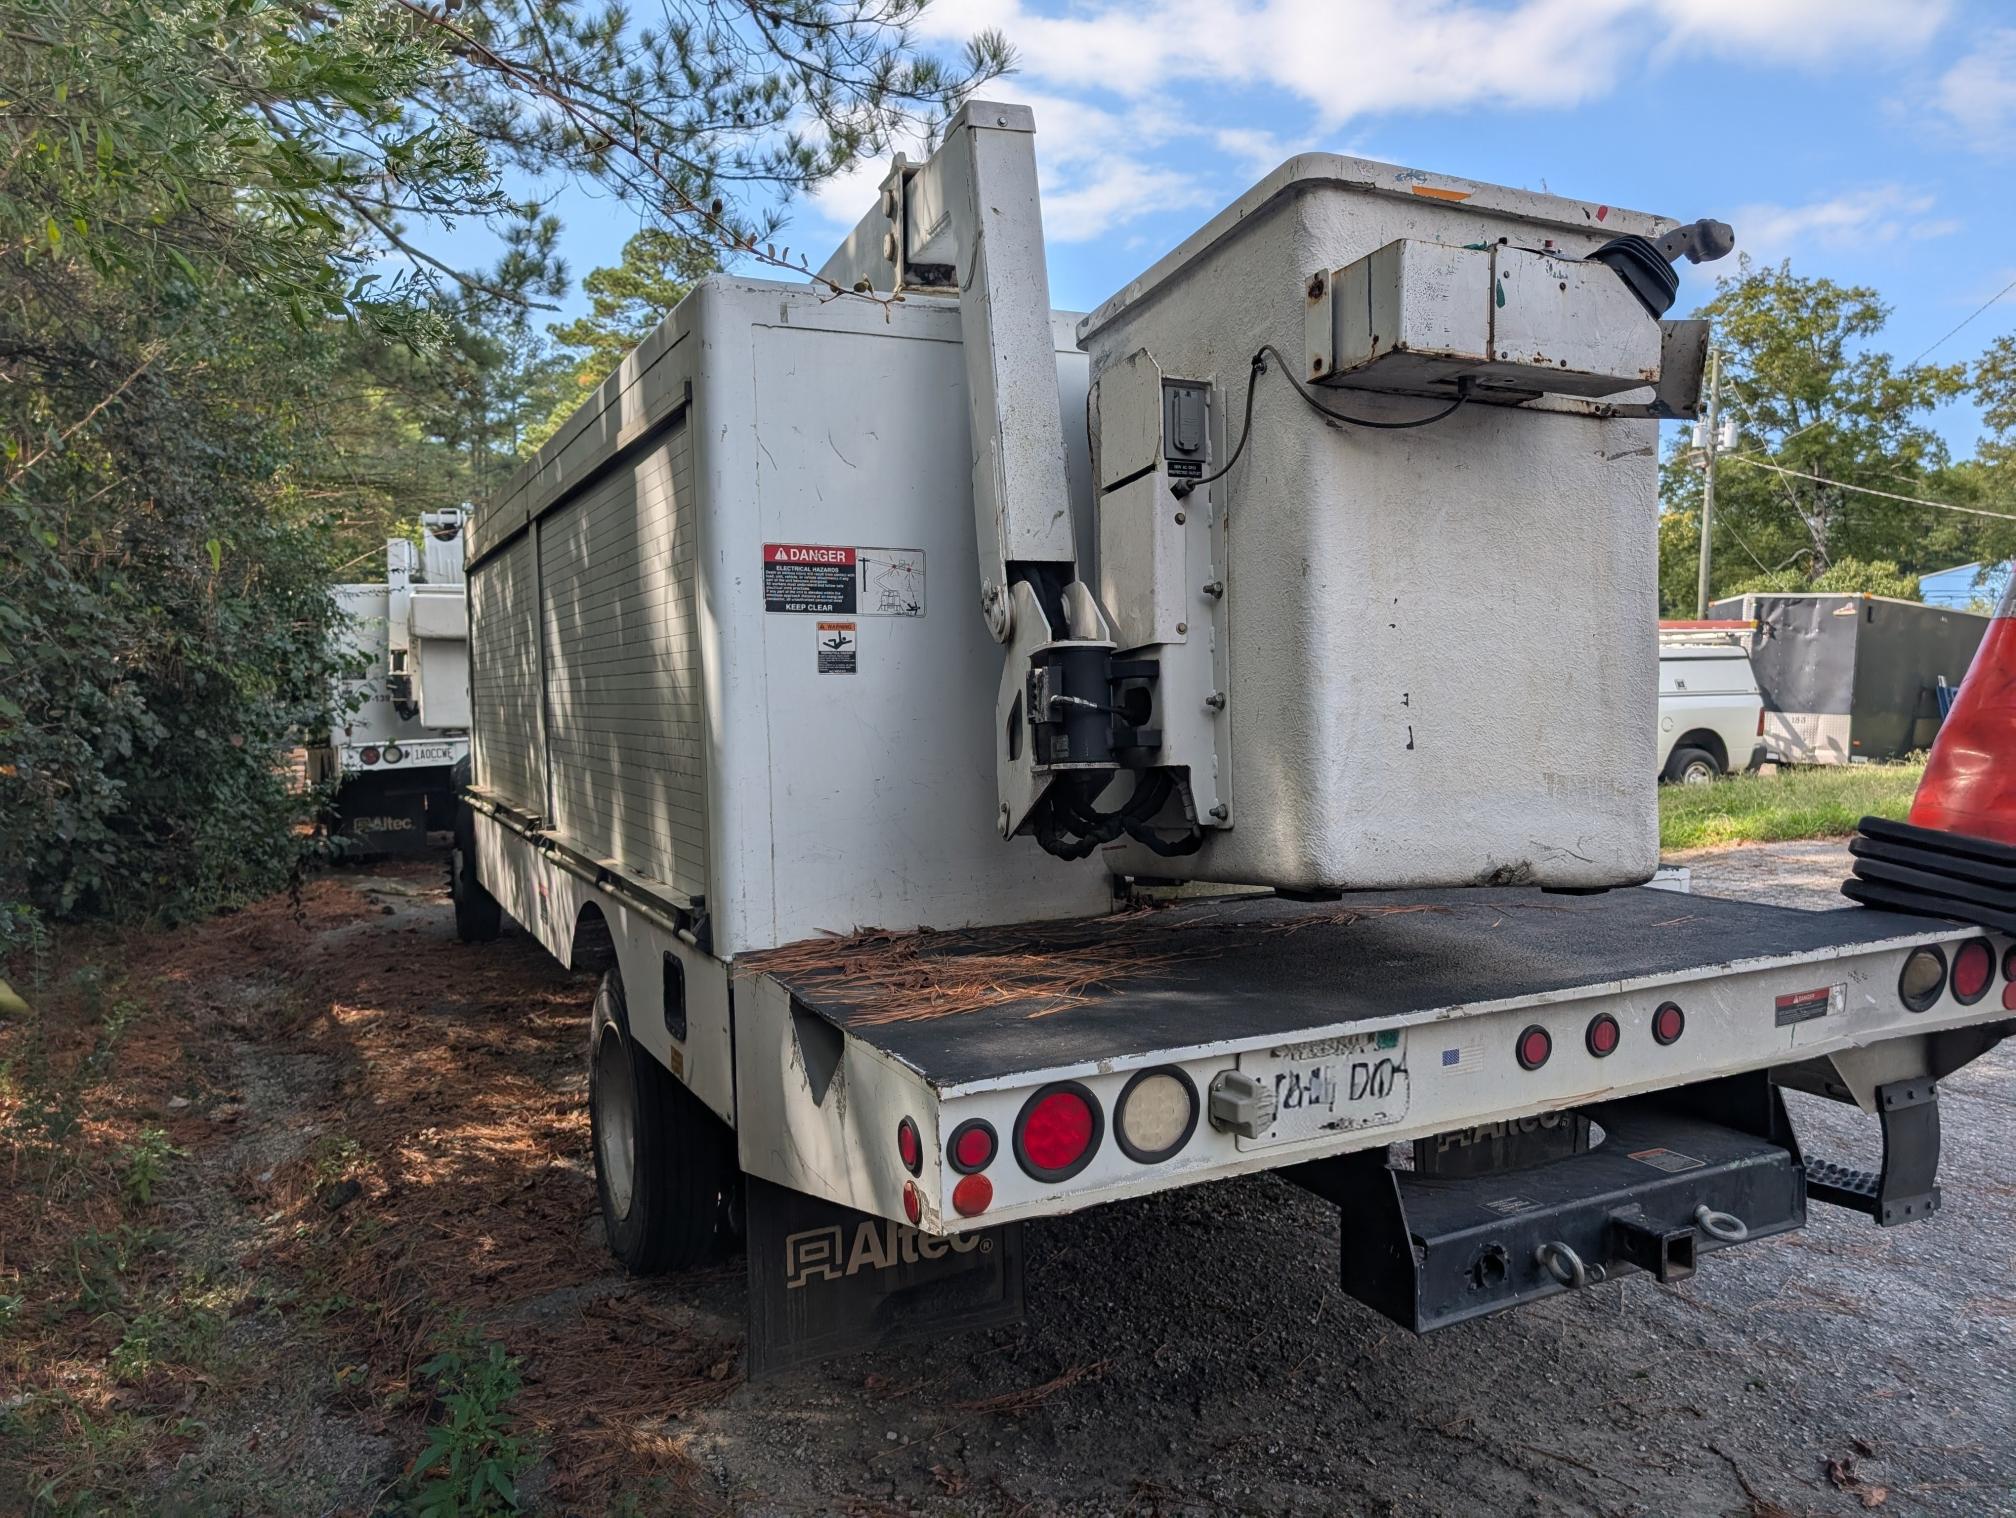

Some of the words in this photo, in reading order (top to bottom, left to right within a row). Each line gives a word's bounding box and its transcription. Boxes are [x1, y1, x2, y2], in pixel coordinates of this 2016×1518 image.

[790, 548, 846, 562] DANGER
[785, 603, 807, 611] KEEP
[808, 604, 833, 612] CLEAR
[845, 1221, 980, 1276] Altec
